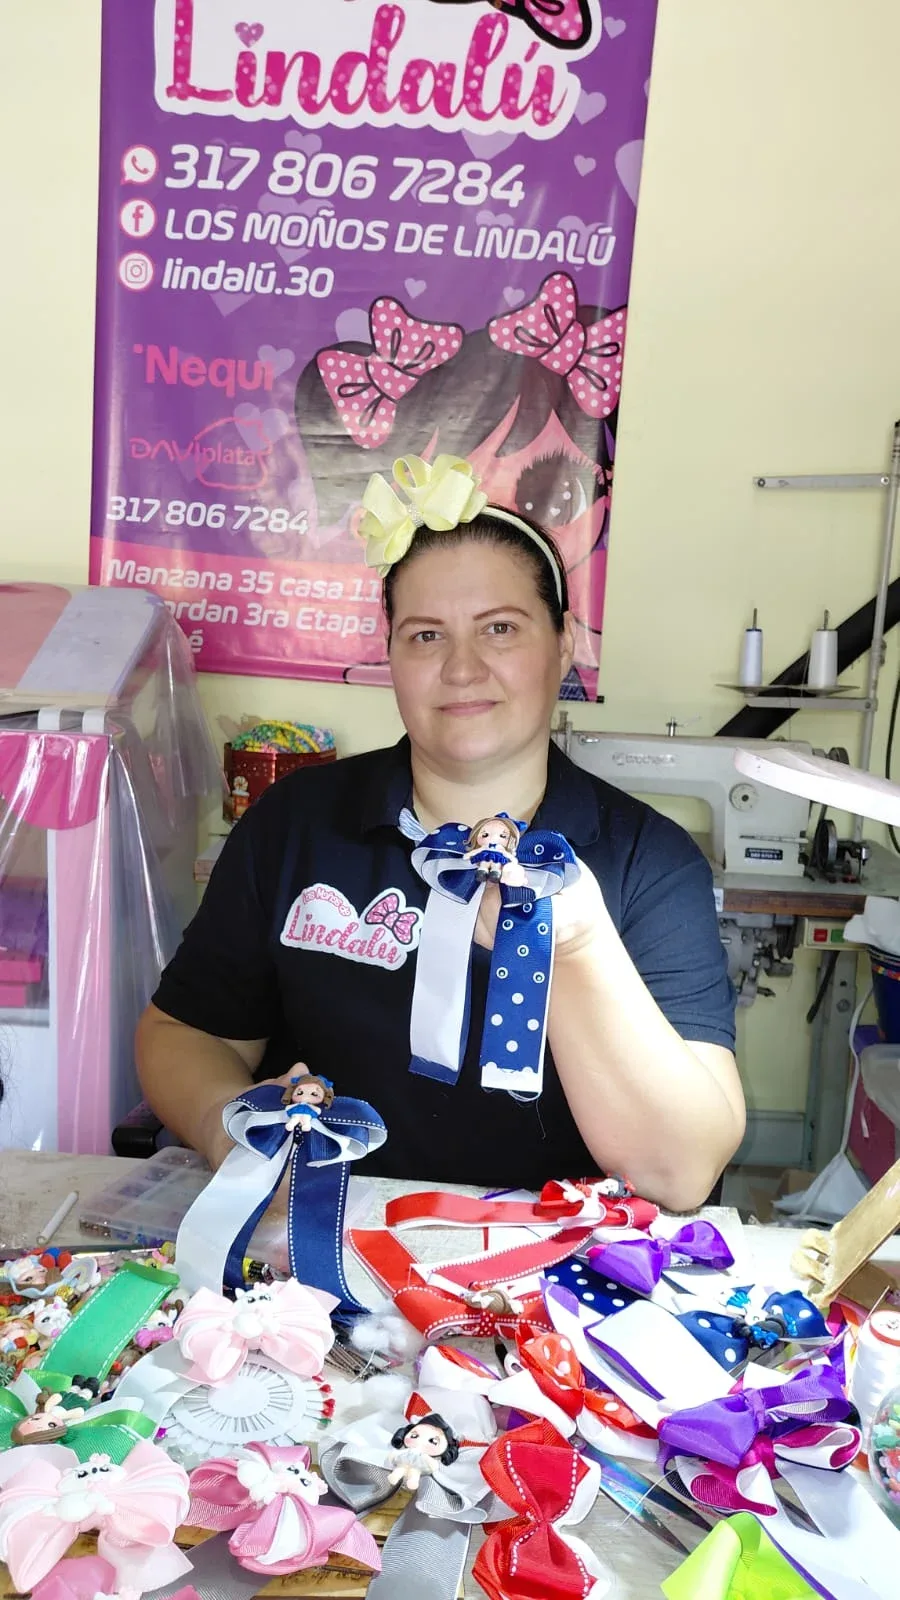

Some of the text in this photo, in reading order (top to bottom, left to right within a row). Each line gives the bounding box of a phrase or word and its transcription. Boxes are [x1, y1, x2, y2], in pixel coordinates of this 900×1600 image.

[166, 0, 569, 127] Lindalú
[165, 144, 525, 207] 317 806 7284
[164, 208, 616, 266] LOS MOÑOS DE LINDALÚ
[162, 259, 334, 298] lindalú.30
[106, 496, 309, 535] 317 806 7284
[107, 559, 380, 602] Manzana 35 casa 11
[163, 598, 377, 639] ordan 3ra Etapa
[285, 905, 401, 964] Lindalú
